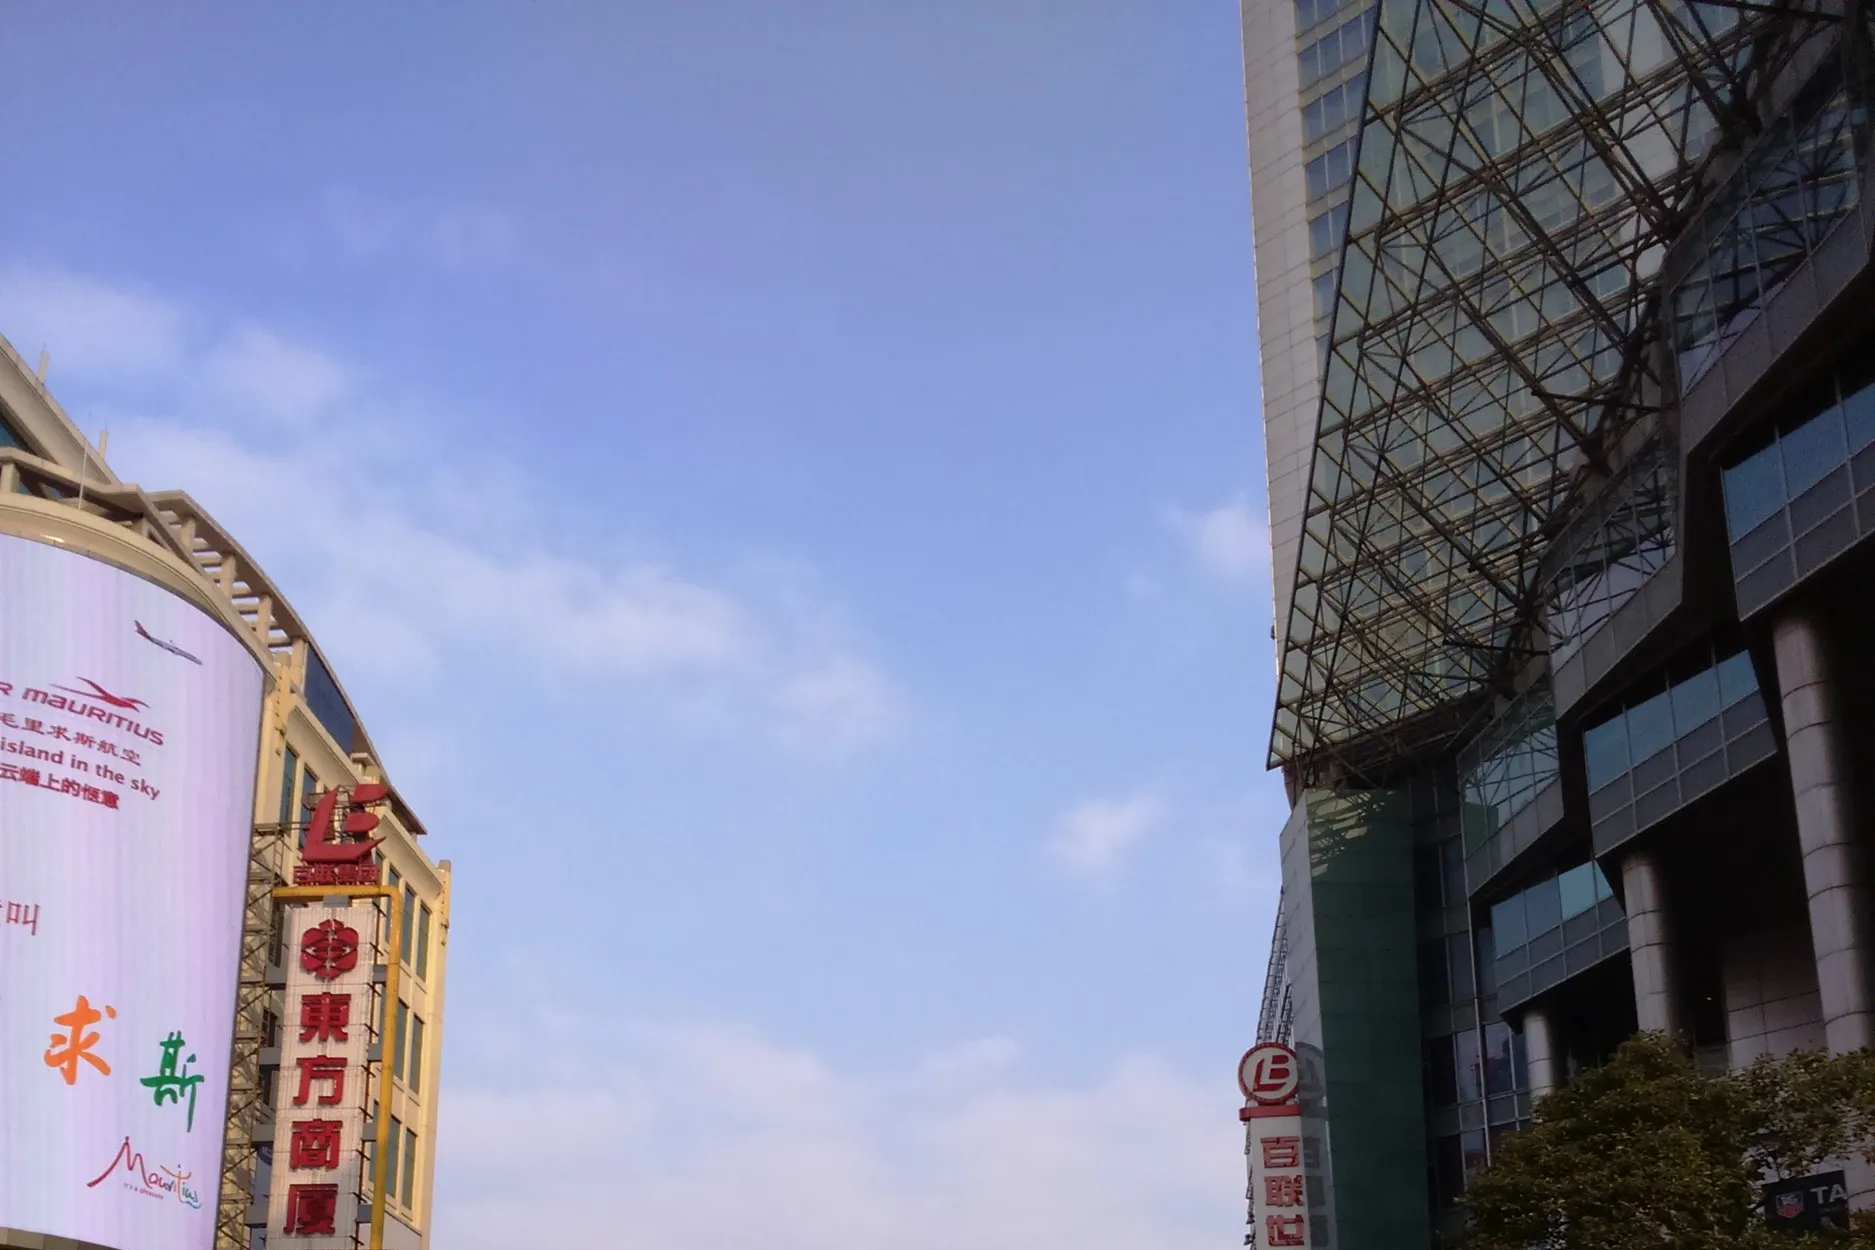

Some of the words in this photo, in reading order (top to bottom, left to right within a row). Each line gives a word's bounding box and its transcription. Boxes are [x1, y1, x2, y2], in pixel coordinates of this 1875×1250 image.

[1, 737, 64, 765] island
[70, 755, 89, 772] in
[95, 764, 125, 785] the
[130, 778, 160, 800] sky
